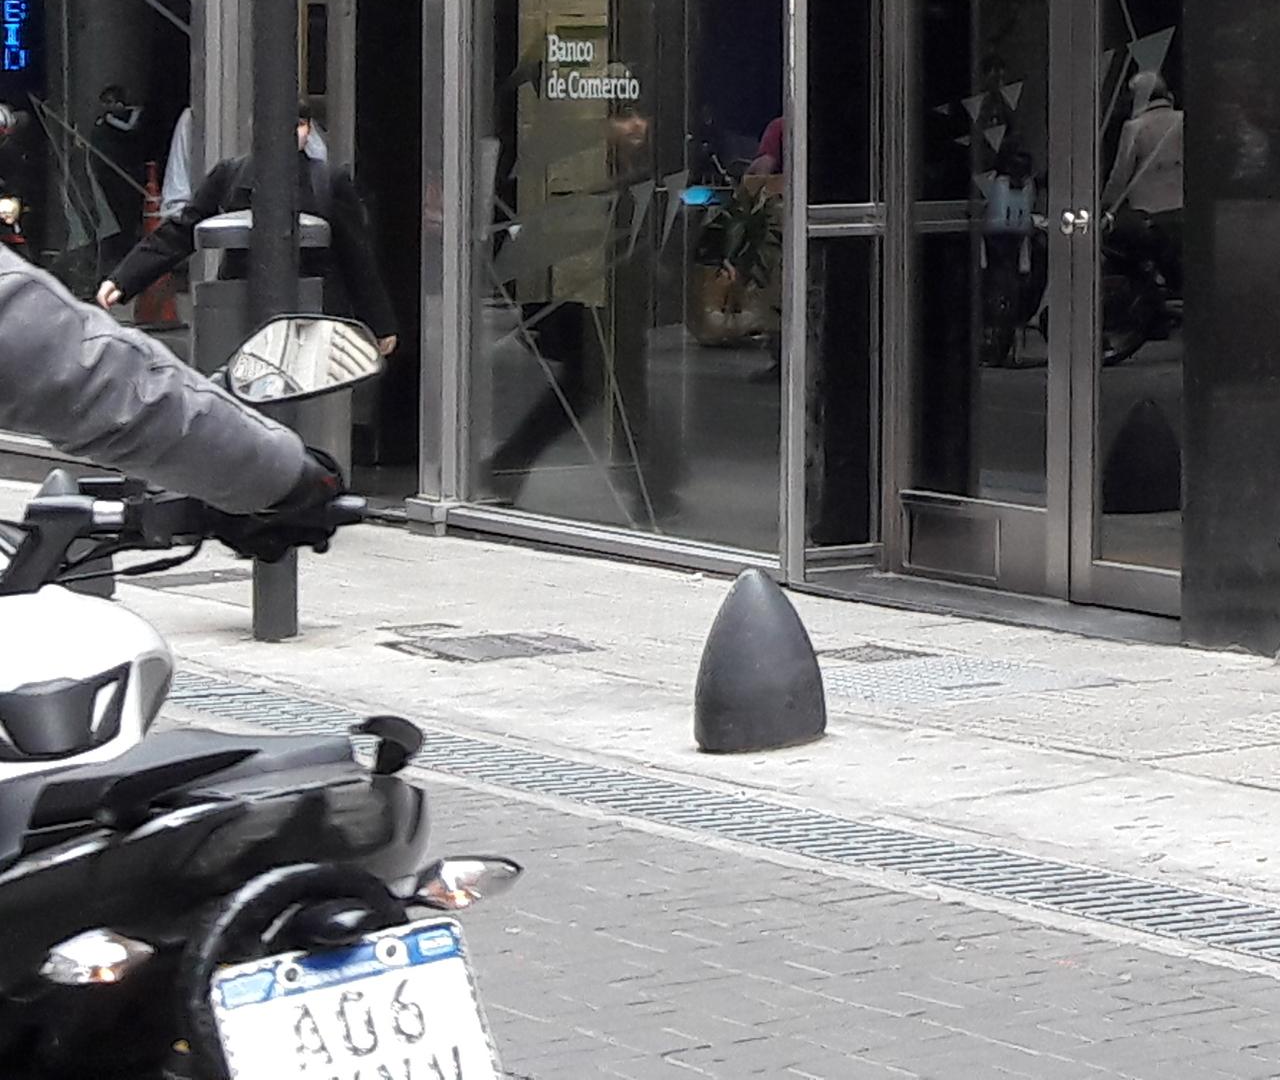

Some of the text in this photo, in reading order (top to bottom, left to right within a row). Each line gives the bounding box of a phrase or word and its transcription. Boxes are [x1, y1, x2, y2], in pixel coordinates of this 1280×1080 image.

[547, 33, 594, 63] Banco
[547, 70, 640, 100] de Comercio
